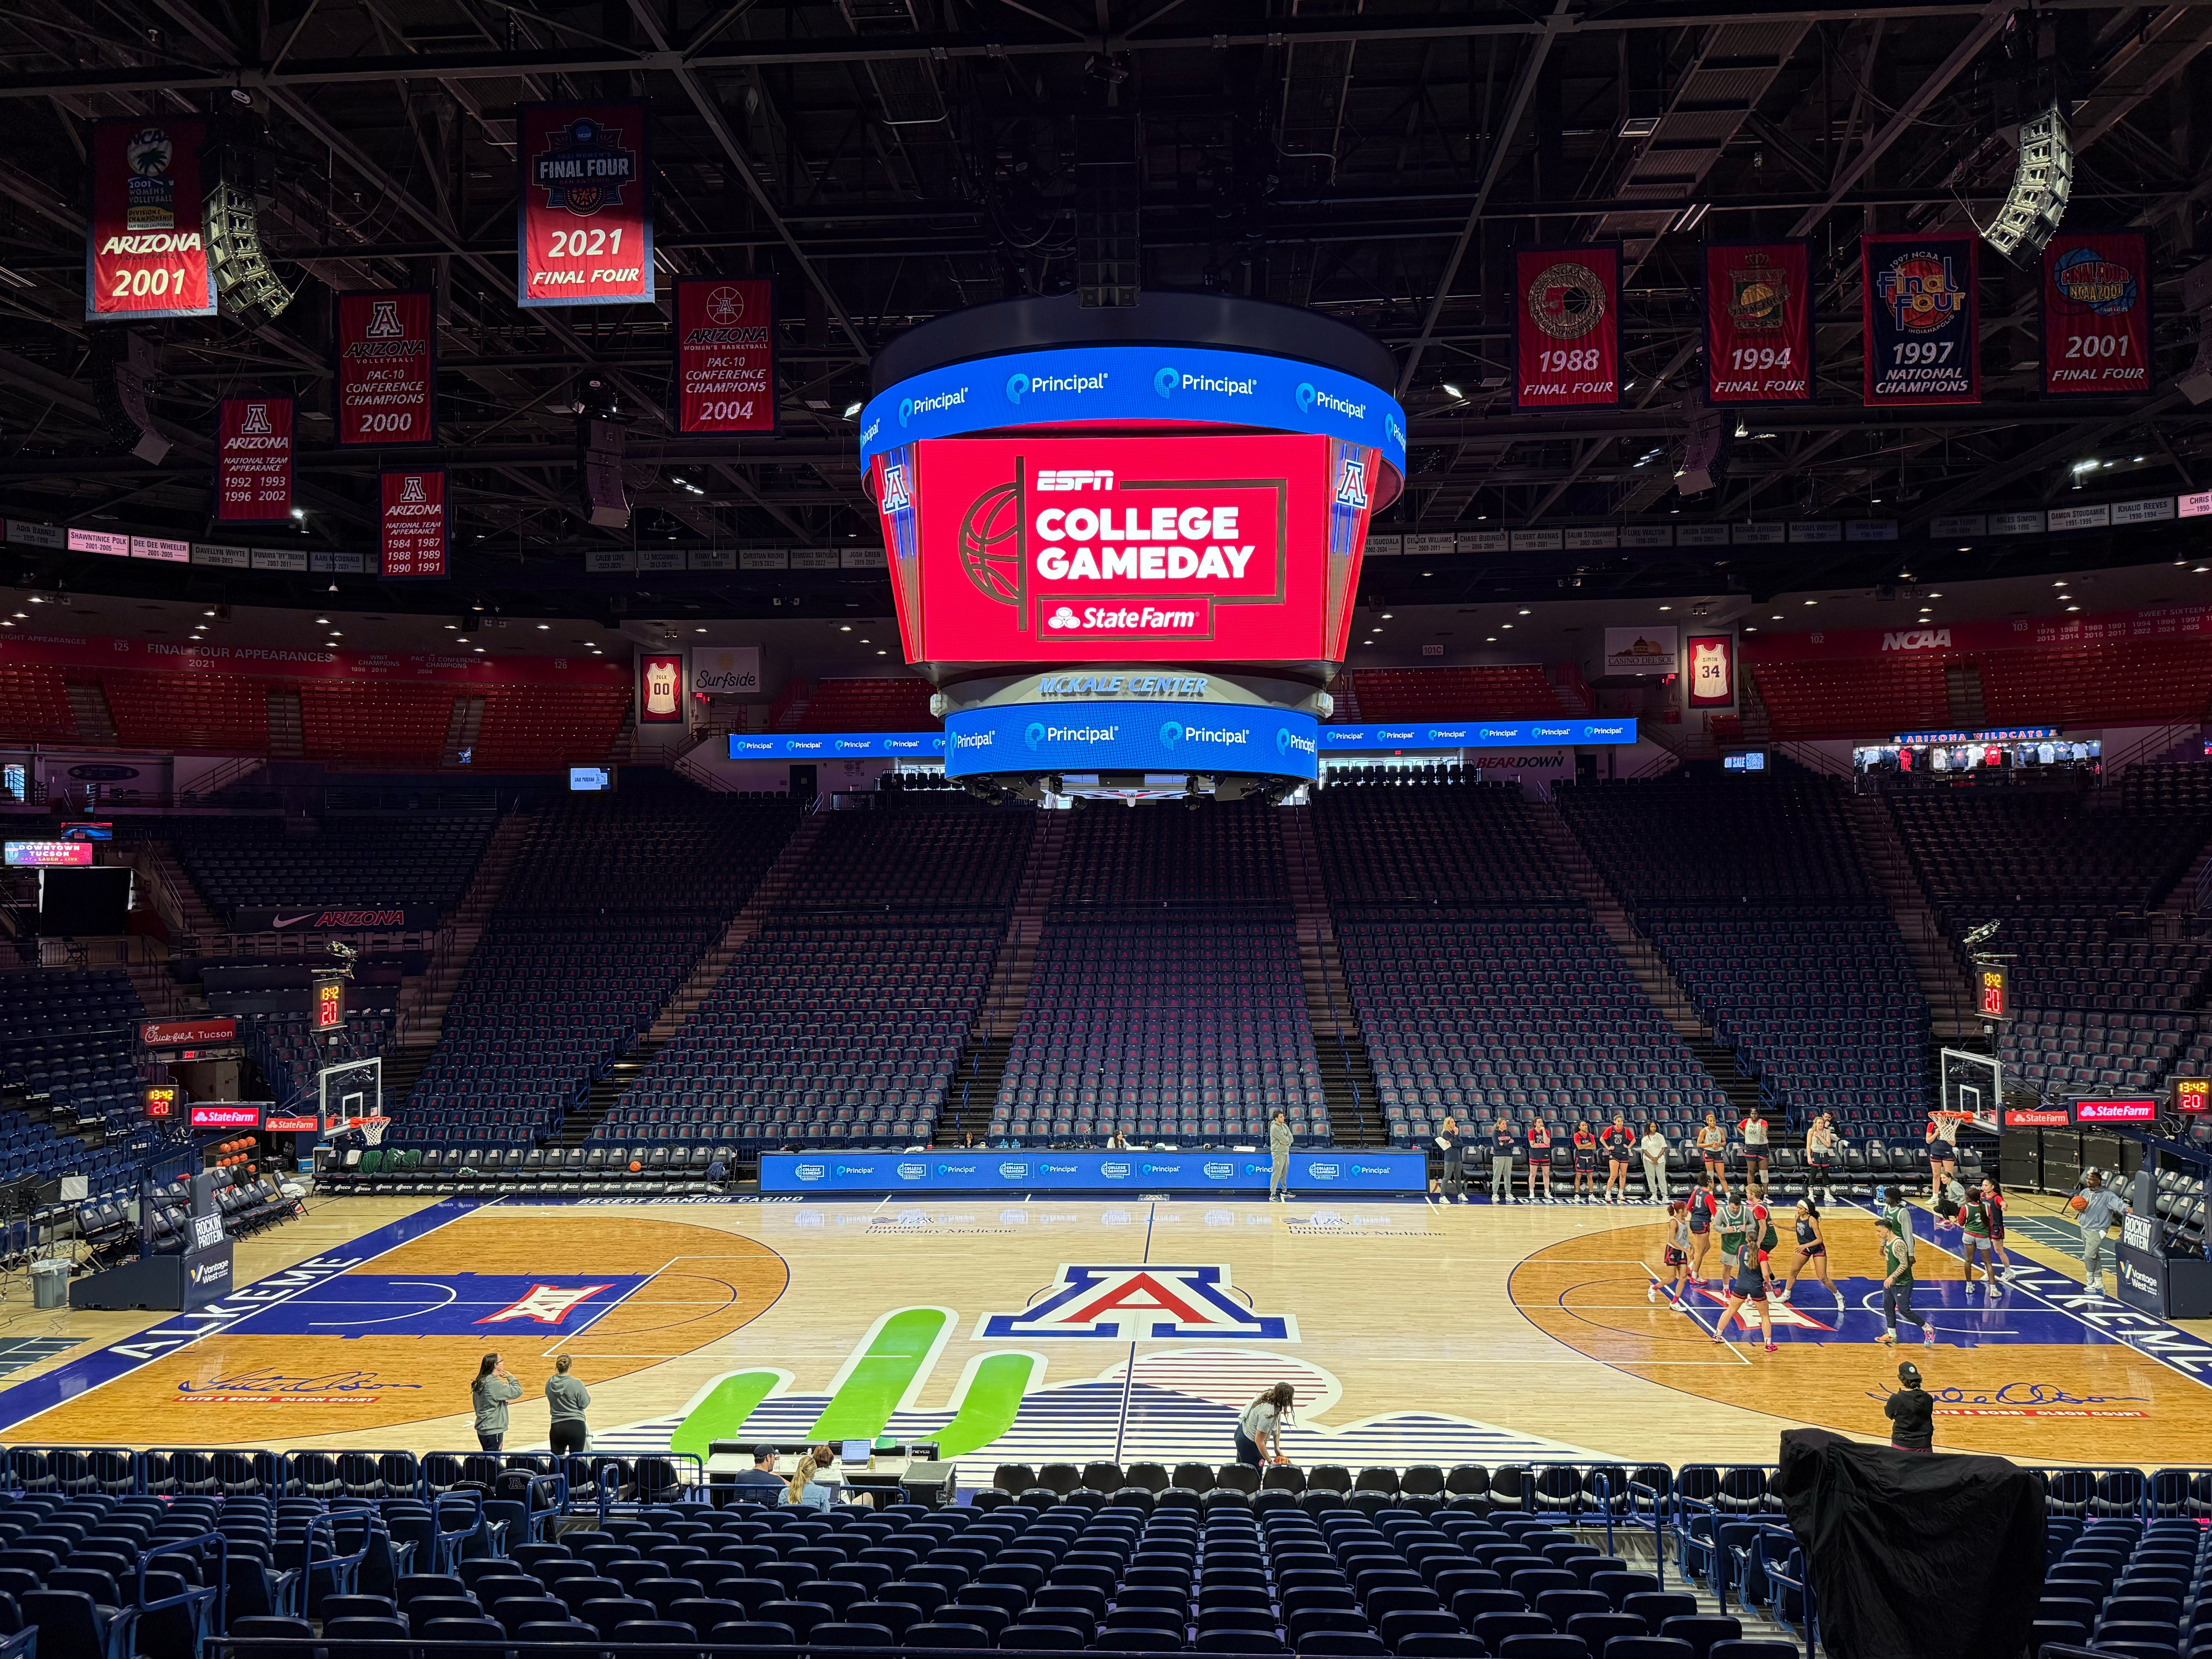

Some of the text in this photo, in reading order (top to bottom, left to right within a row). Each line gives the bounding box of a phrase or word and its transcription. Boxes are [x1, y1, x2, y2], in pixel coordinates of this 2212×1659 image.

[540, 158, 629, 179] FINAL FOUR
[101, 233, 201, 254] ARIZONA
[548, 229, 622, 257] 2021
[112, 269, 185, 296] 2001
[533, 268, 640, 285] FINAL FOUR
[684, 327, 768, 343] ARIZONA
[343, 340, 425, 357] ARIZONA
[1893, 342, 1954, 364] 1997
[2066, 335, 2129, 358] 2001
[707, 357, 745, 367] PAC-10
[1540, 349, 1600, 372] 1988
[1732, 347, 1791, 370] 1994
[367, 370, 404, 380] PAC-10
[686, 369, 766, 380] CONFERENCE
[1885, 367, 1962, 380] NATIONAL
[2052, 368, 2145, 381] FINAL FOUR
[346, 381, 424, 393] CONFERENCE
[686, 382, 766, 393] CHAMPIONS
[1523, 382, 1613, 395] FINAL FOUR
[1715, 381, 1805, 393] FINAL FOUR
[1876, 380, 1968, 394] CHAMPIONS
[346, 394, 425, 405] CHAMPIONS
[700, 401, 753, 420] 2004
[360, 413, 412, 432] 2000
[224, 437, 288, 449] ARIZONA
[225, 477, 252, 487] 1992
[260, 477, 286, 486] 1993
[1037, 470, 1114, 491] ESPN
[225, 491, 252, 501] 1996
[258, 491, 286, 501] 2002
[385, 505, 441, 516] ARIZONA
[2143, 501, 2167, 509] REEVES
[2051, 511, 2070, 520] DAMON
[1036, 507, 1239, 541] COLLEGE
[32, 526, 56, 537] BARNES
[71, 532, 110, 543] SHAWNTINICE
[85, 542, 112, 551] 2001-2005
[160, 542, 186, 551] WHEELER
[388, 539, 410, 548] 1984
[418, 538, 440, 547] 1987
[195, 546, 246, 557] DAVELLYN WHYTE
[388, 552, 411, 560] 1988
[418, 550, 440, 559] 1989
[388, 564, 411, 572] 1990
[418, 562, 440, 571] 1991
[1037, 546, 1255, 580] GAMEDAY
[2169, 606, 2205, 615] SIXTEEN
[2013, 622, 2028, 631] 103
[28, 635, 86, 645] APPEARANCES
[1810, 635, 1824, 644] 102
[1882, 629, 1951, 651] NCAA
[113, 642, 129, 651] 125
[147, 643, 333, 662] FINAL FOUR APPEARANCES
[189, 659, 215, 668] 2021
[1609, 656, 1639, 665] CASINO
[1702, 665, 1720, 678] 34
[697, 670, 756, 688] Surfside
[1038, 676, 1208, 693] MCKALE CENTER
[654, 683, 669, 695] 00
[1906, 730, 2043, 742] ARIZONA WILDCATS
[1733, 757, 1745, 767] SALE
[314, 910, 404, 926] ARIZONA
[1984, 972, 2001, 988] 13:42
[322, 986, 339, 1000] 13:42
[1985, 988, 2001, 1013] 20
[322, 1001, 337, 1024] 20
[2178, 1082, 2208, 1093] 13:42
[150, 1090, 173, 1100] 13:42
[2182, 1094, 2202, 1109] 20
[152, 1101, 169, 1114] 20
[1695, 1194, 1702, 1208] 13
[195, 1215, 222, 1237] ROCKIN'
[2124, 1216, 2151, 1238] ROCKIN'
[197, 1228, 225, 1249] PROTEIN
[2124, 1230, 2149, 1252] PROTEIN
[203, 1260, 228, 1275] Vantage
[203, 1272, 219, 1284] West
[2132, 1268, 2157, 1286] Vantage
[2131, 1277, 2147, 1292] West
[108, 1257, 363, 1359] ALKEME
